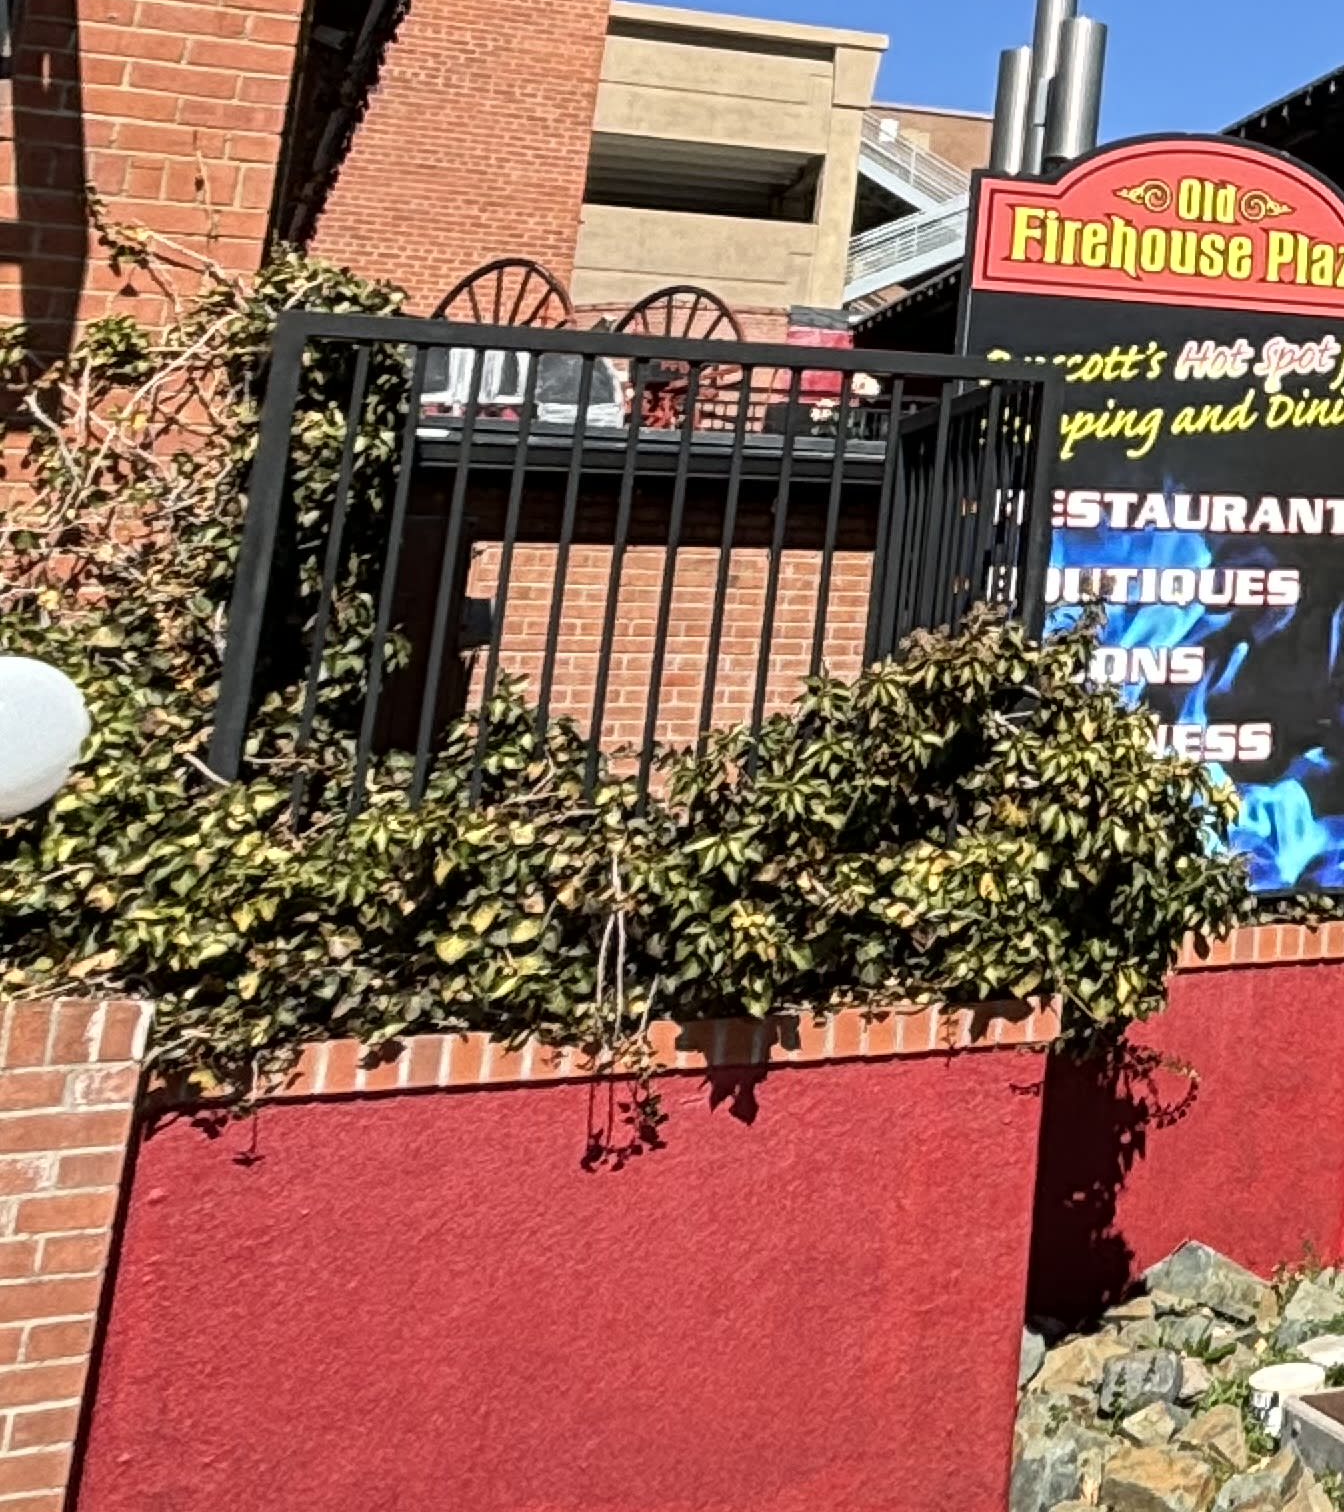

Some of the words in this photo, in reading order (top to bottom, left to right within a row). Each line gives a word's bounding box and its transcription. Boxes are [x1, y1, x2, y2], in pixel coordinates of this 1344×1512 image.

[1178, 178, 1236, 223] Old
[1011, 207, 1253, 281] Firehouse
[1175, 339, 1249, 380] Hot
[1254, 334, 1340, 396] Spot
[1171, 389, 1258, 436] and
[987, 566, 1301, 607] UTIQUES
